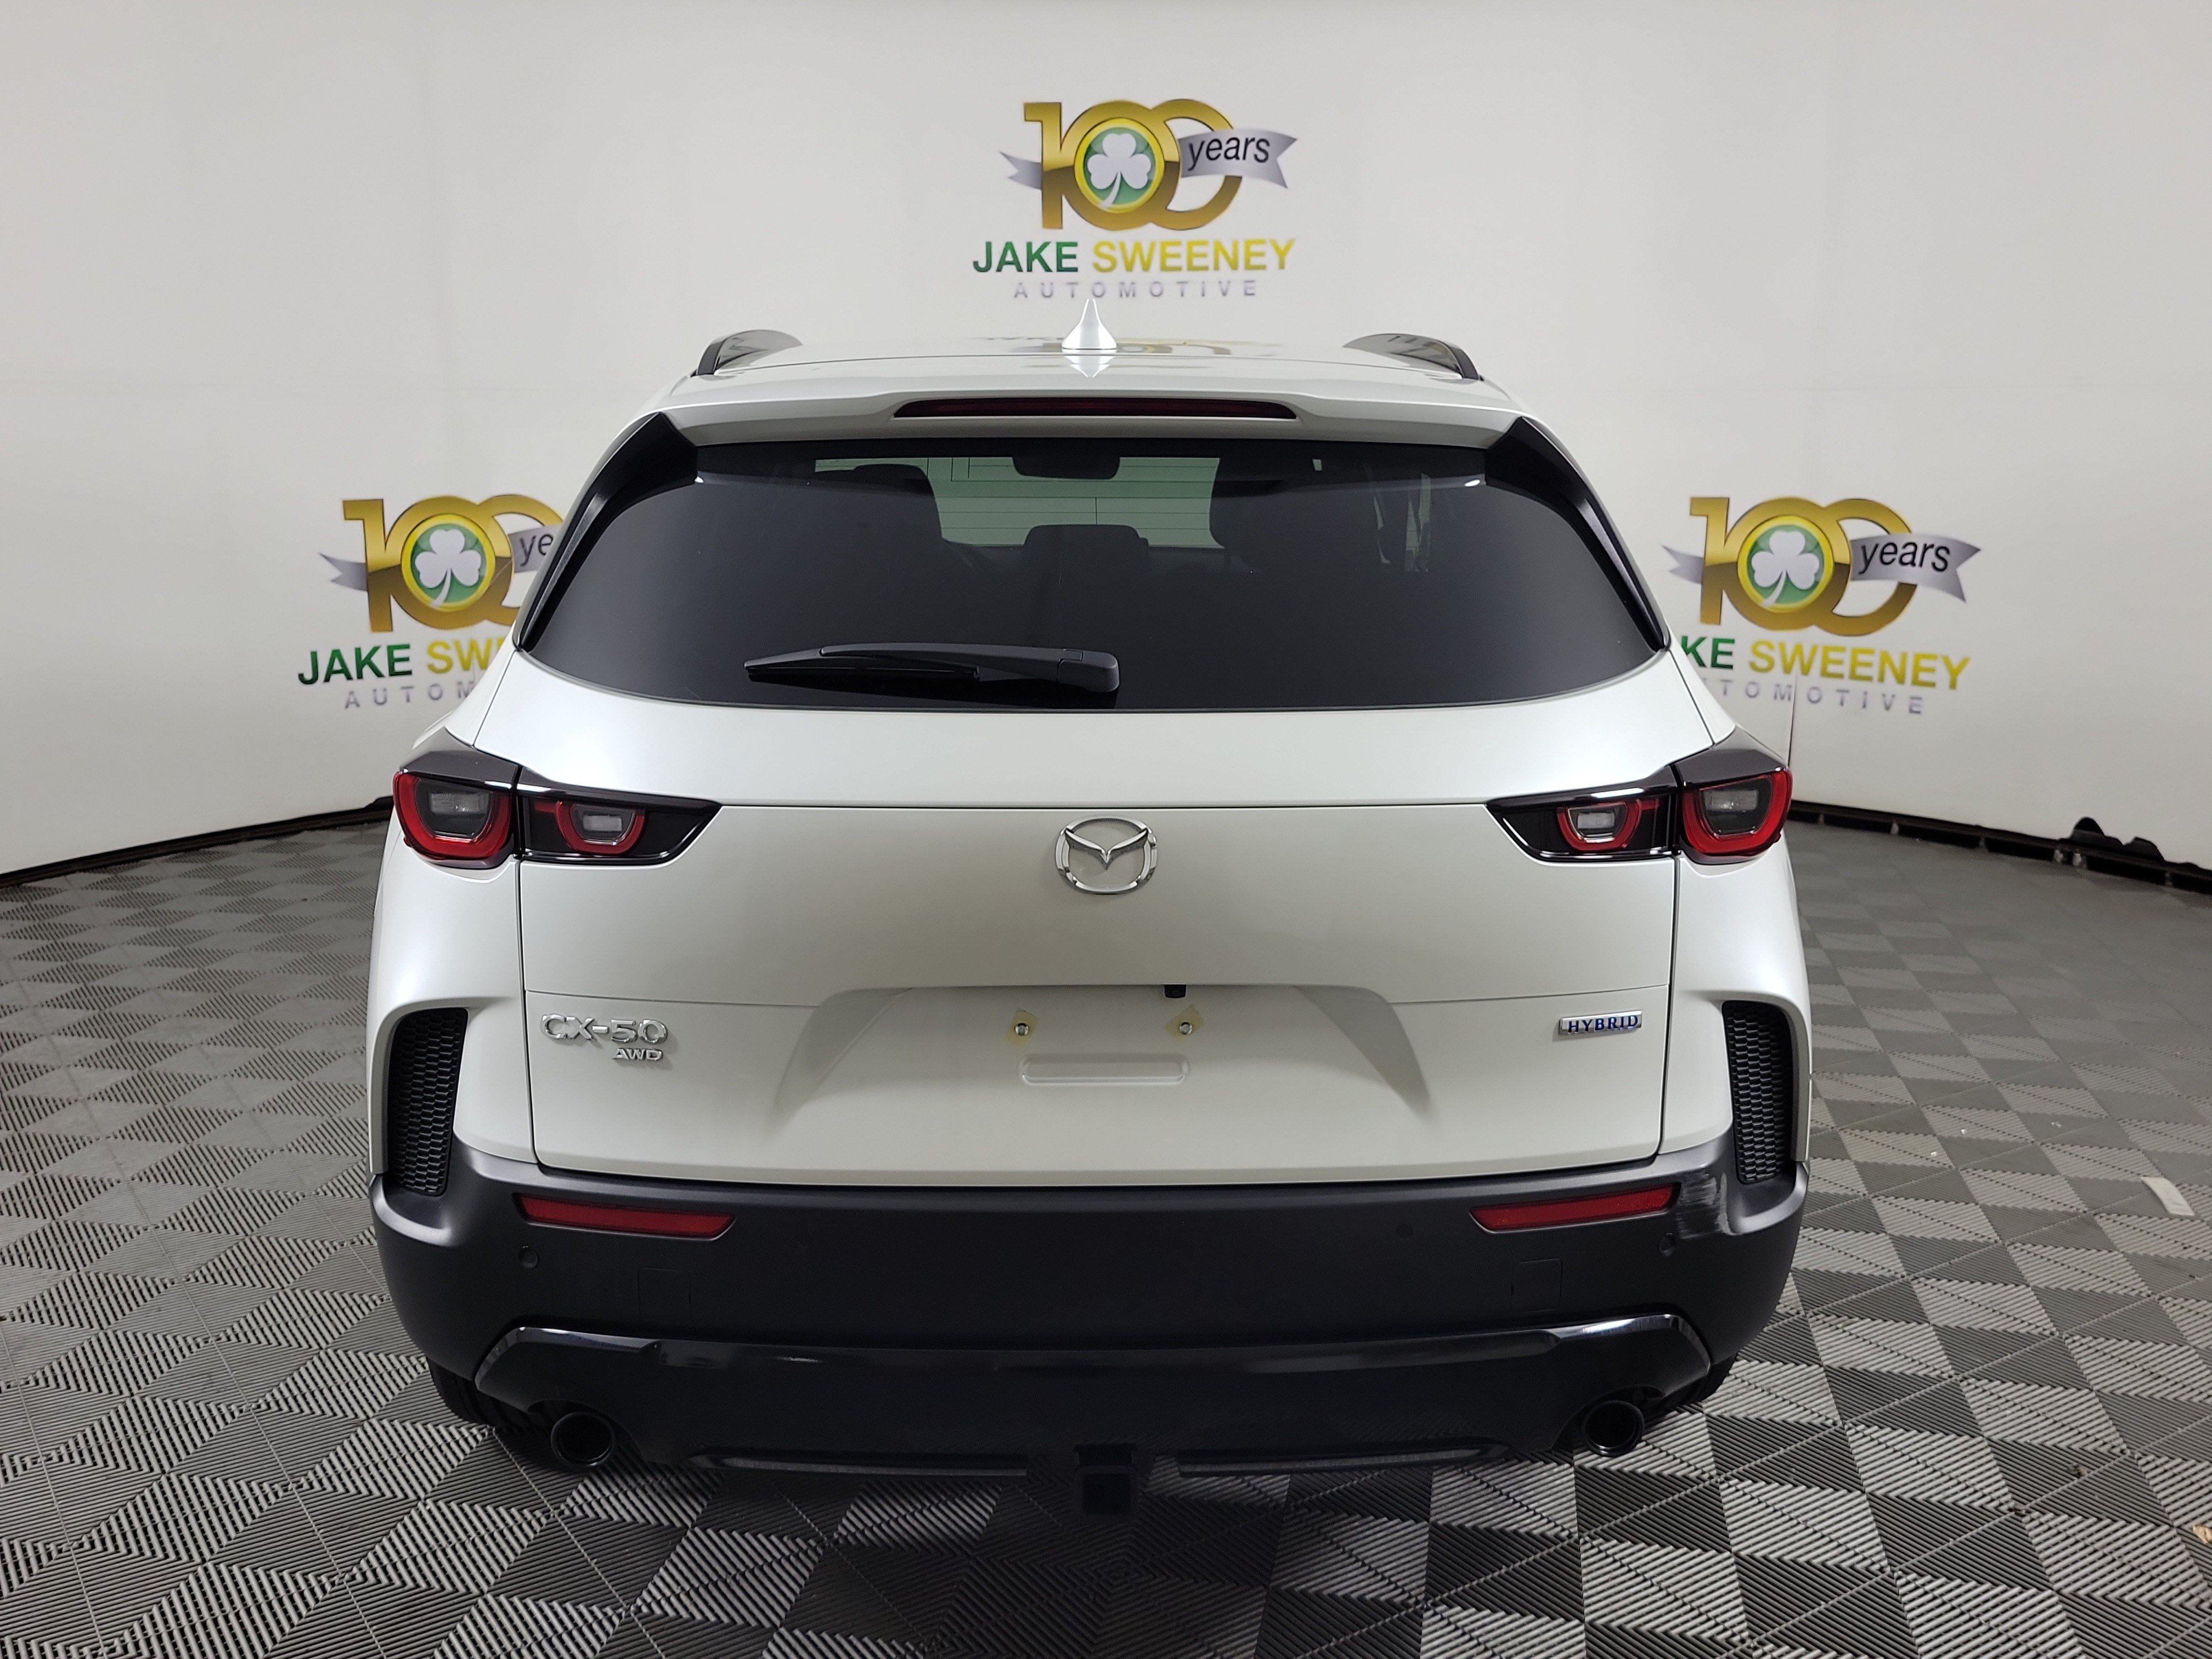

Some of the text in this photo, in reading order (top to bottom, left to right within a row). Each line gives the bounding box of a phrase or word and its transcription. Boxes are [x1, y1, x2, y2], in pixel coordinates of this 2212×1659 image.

[1023, 98, 1270, 232] 100 years
[973, 238, 1296, 273] JAKE SWEENEY
[1013, 280, 1256, 299] AUTOMOTIVE
[1689, 496, 1950, 637] 100 years
[298, 636, 505, 686] JAKE SW
[1748, 638, 1971, 691] SWEENEY
[1702, 677, 1924, 715] TOMOTIVE
[540, 1013, 668, 1045] CX-50
[1568, 1014, 1639, 1033] HYBRID
[612, 1048, 663, 1062] AWD
